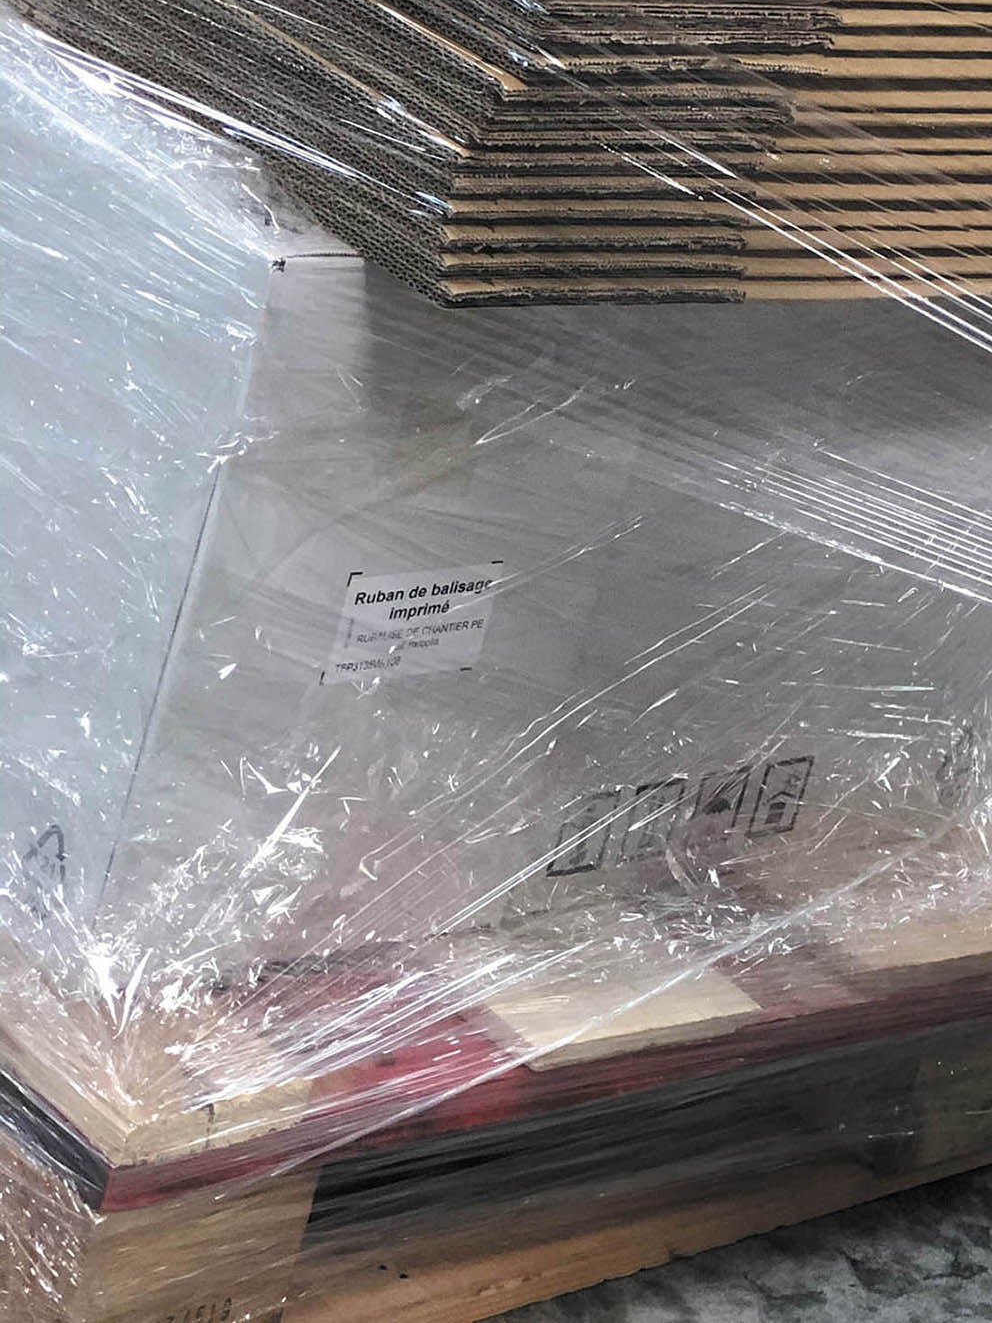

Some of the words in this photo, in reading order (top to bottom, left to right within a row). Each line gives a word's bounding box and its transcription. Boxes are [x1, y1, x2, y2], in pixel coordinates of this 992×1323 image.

[354, 589, 404, 606] Ruban
[408, 586, 427, 600] de
[389, 600, 451, 621] imprimé
[470, 618, 484, 630] PE
